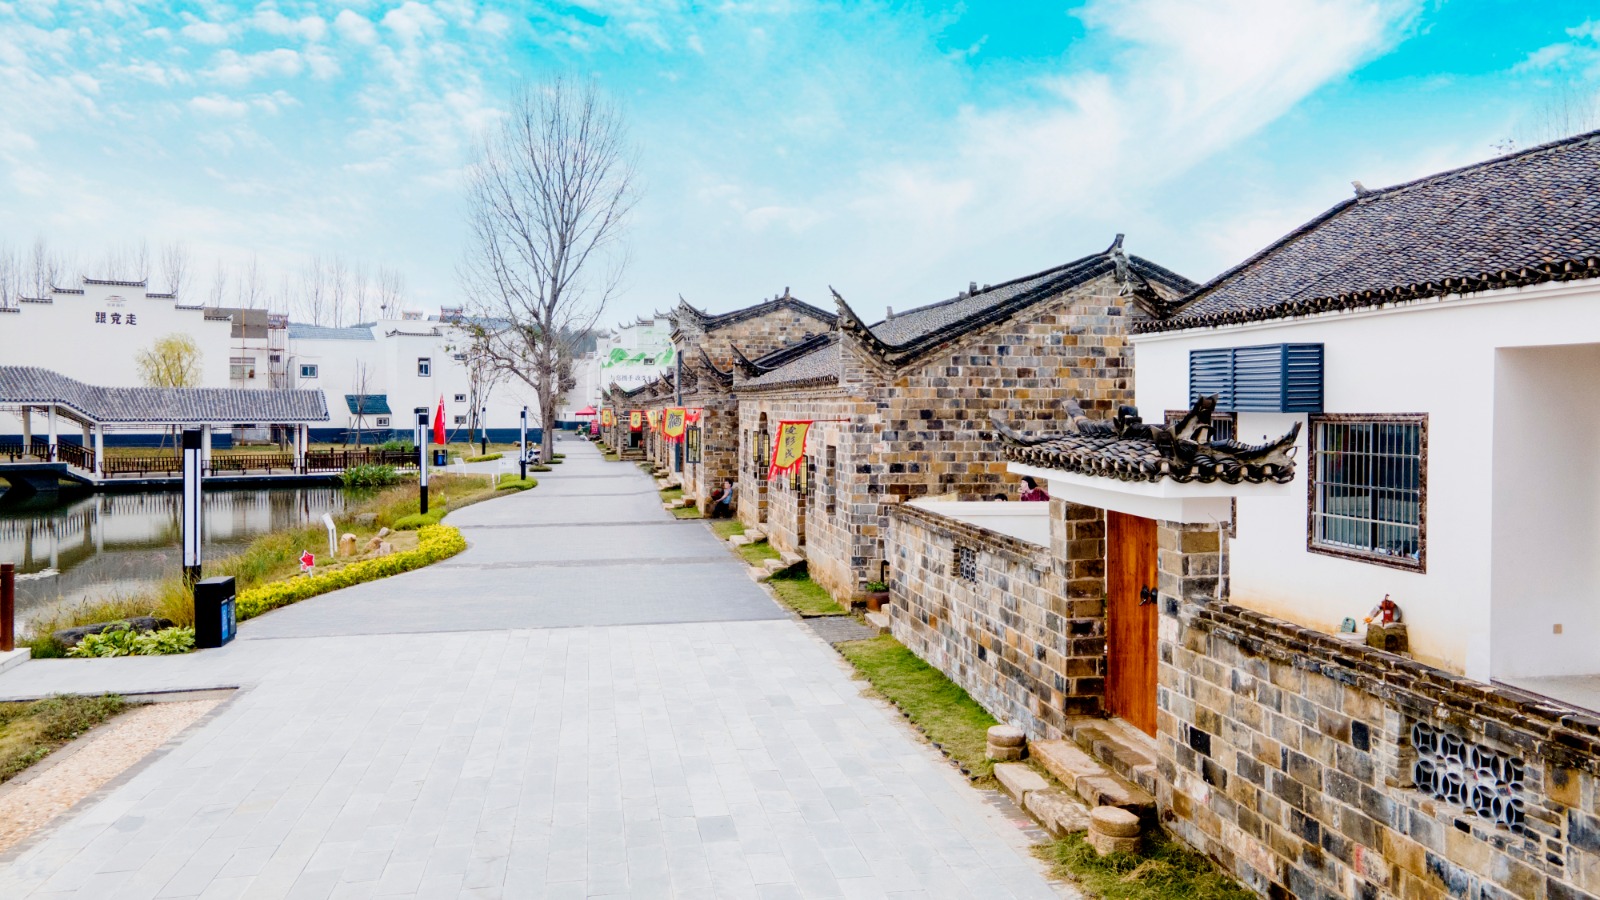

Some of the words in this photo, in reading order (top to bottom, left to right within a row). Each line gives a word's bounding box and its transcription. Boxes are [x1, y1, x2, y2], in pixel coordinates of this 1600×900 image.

[95, 312, 137, 325] 跟党走
[668, 413, 682, 429] 酒
